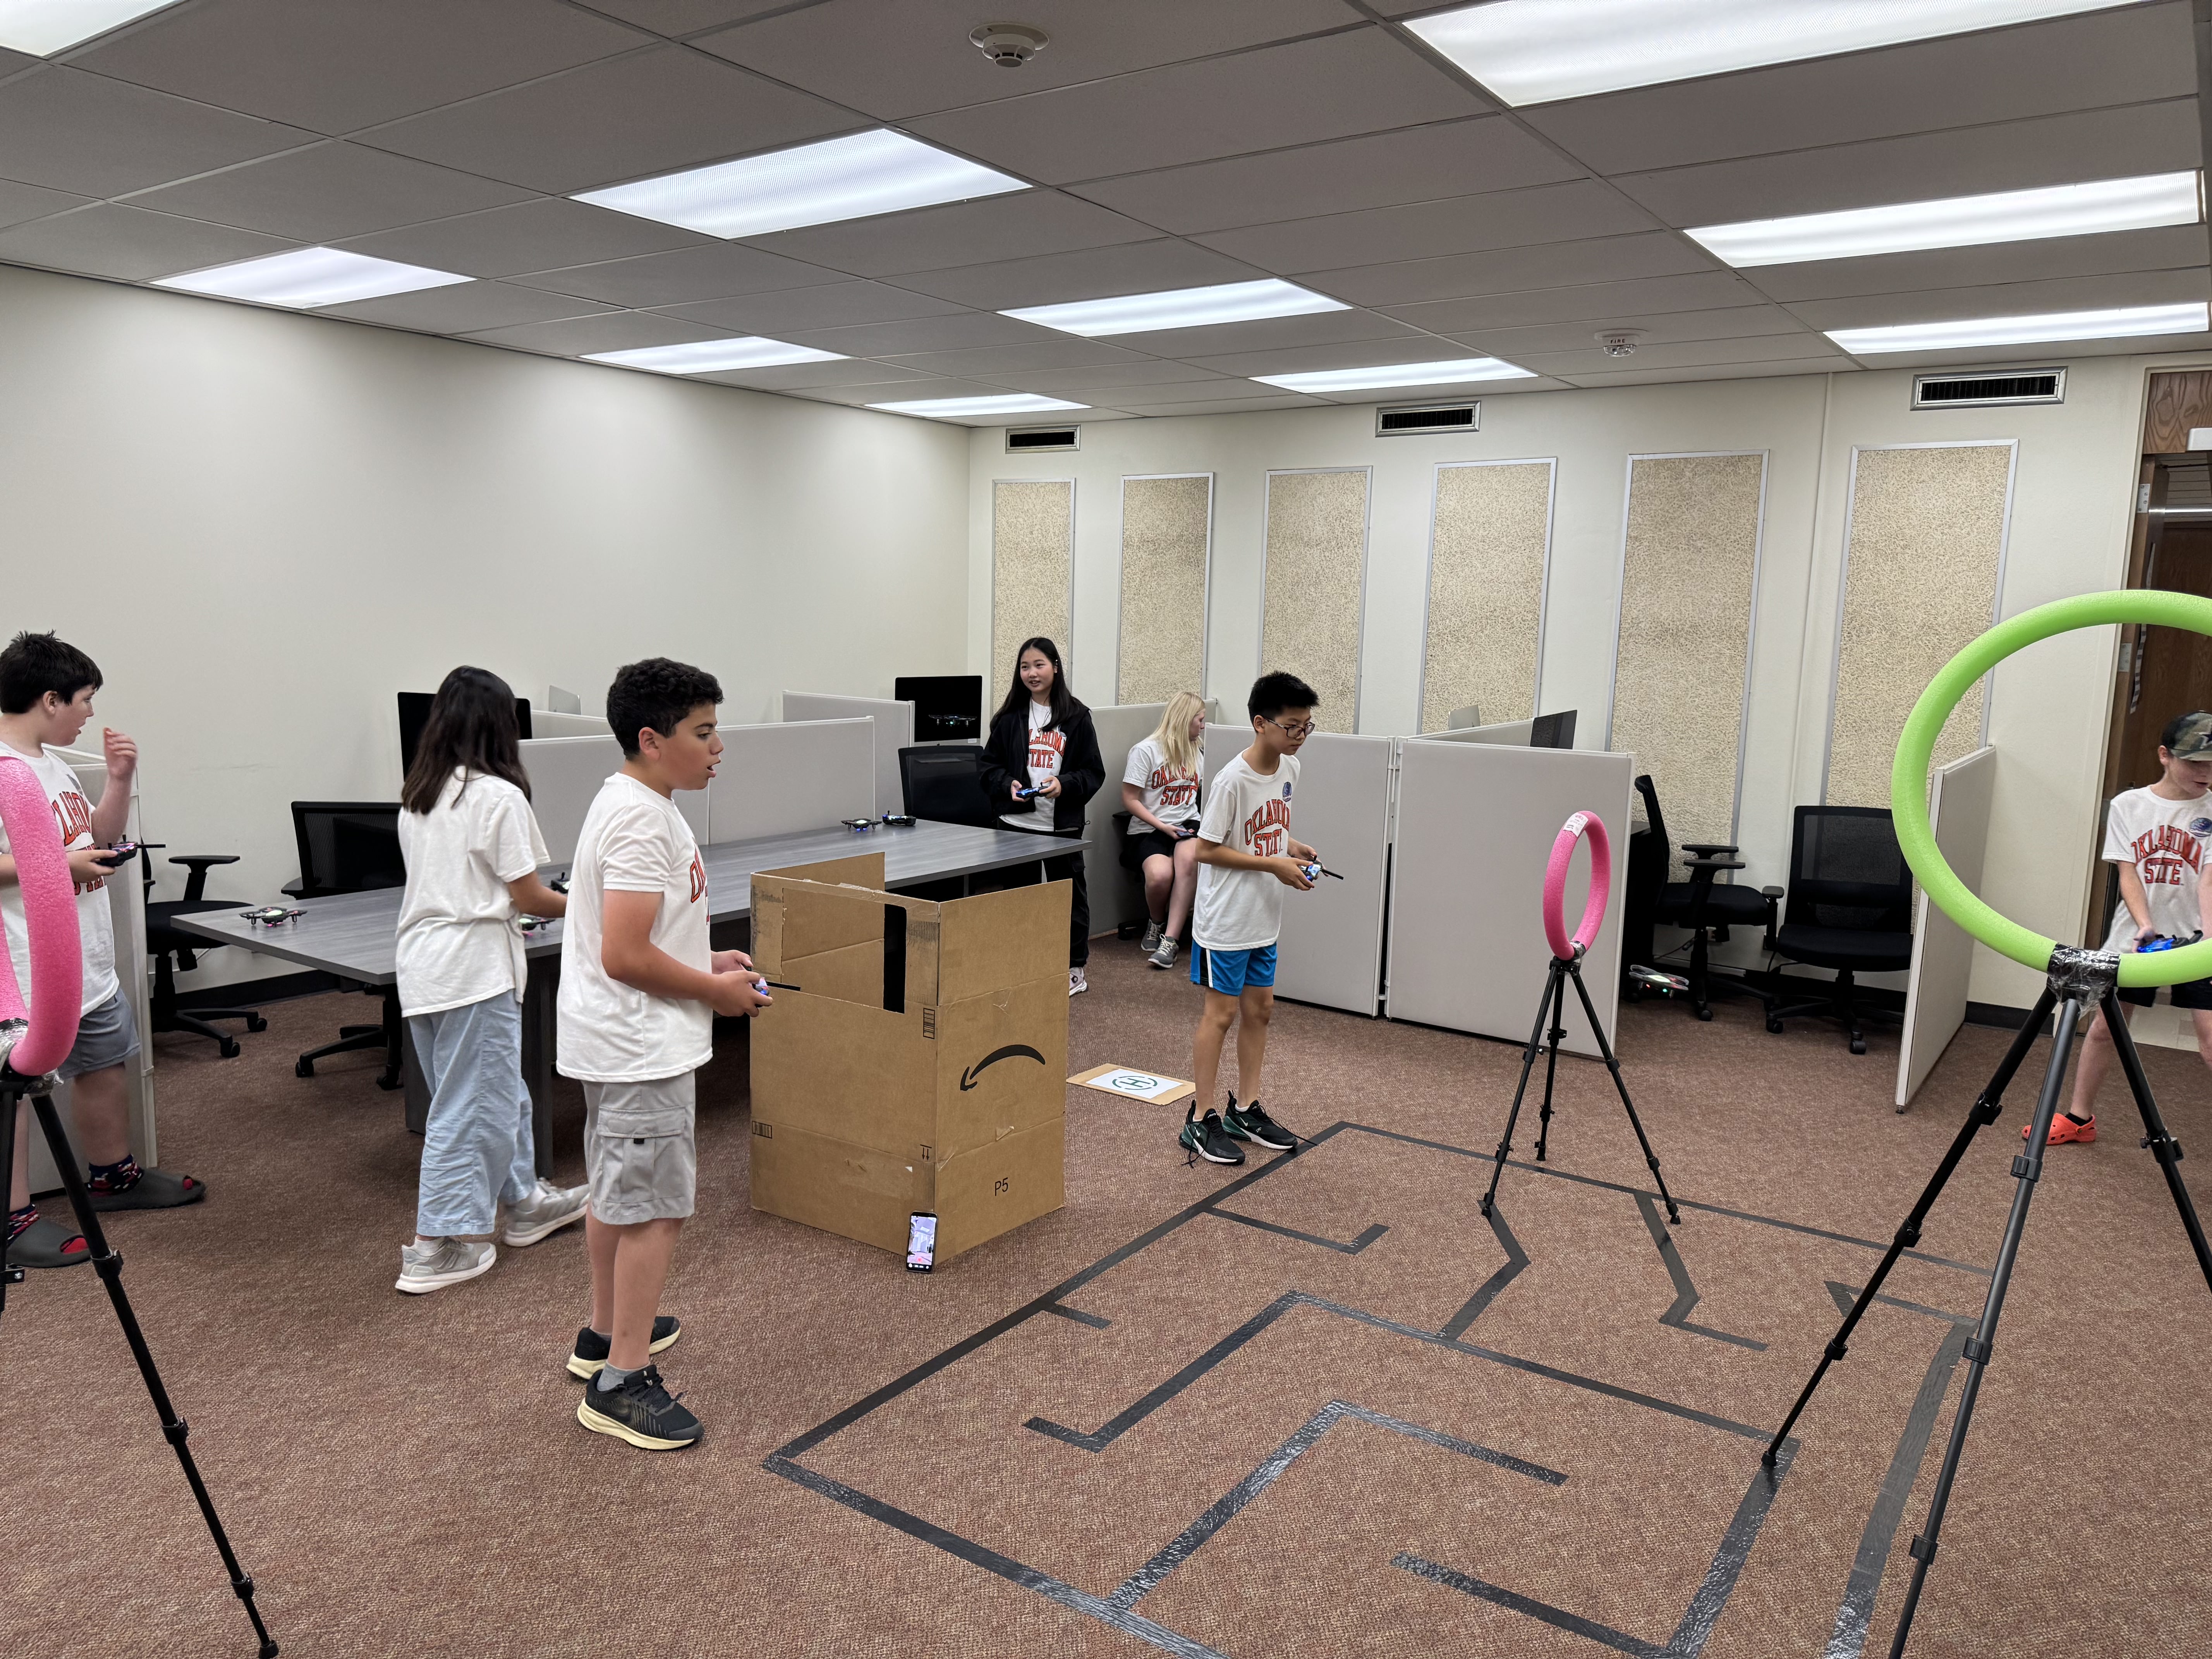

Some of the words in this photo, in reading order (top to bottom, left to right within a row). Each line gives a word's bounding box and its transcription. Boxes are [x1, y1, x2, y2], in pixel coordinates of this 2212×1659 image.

[1029, 728, 1066, 757] LAHOM
[1027, 749, 1054, 769] TATE
[1254, 829, 1282, 857] STT
[2145, 857, 2183, 885] STE
[995, 1177, 1008, 1196] P5
